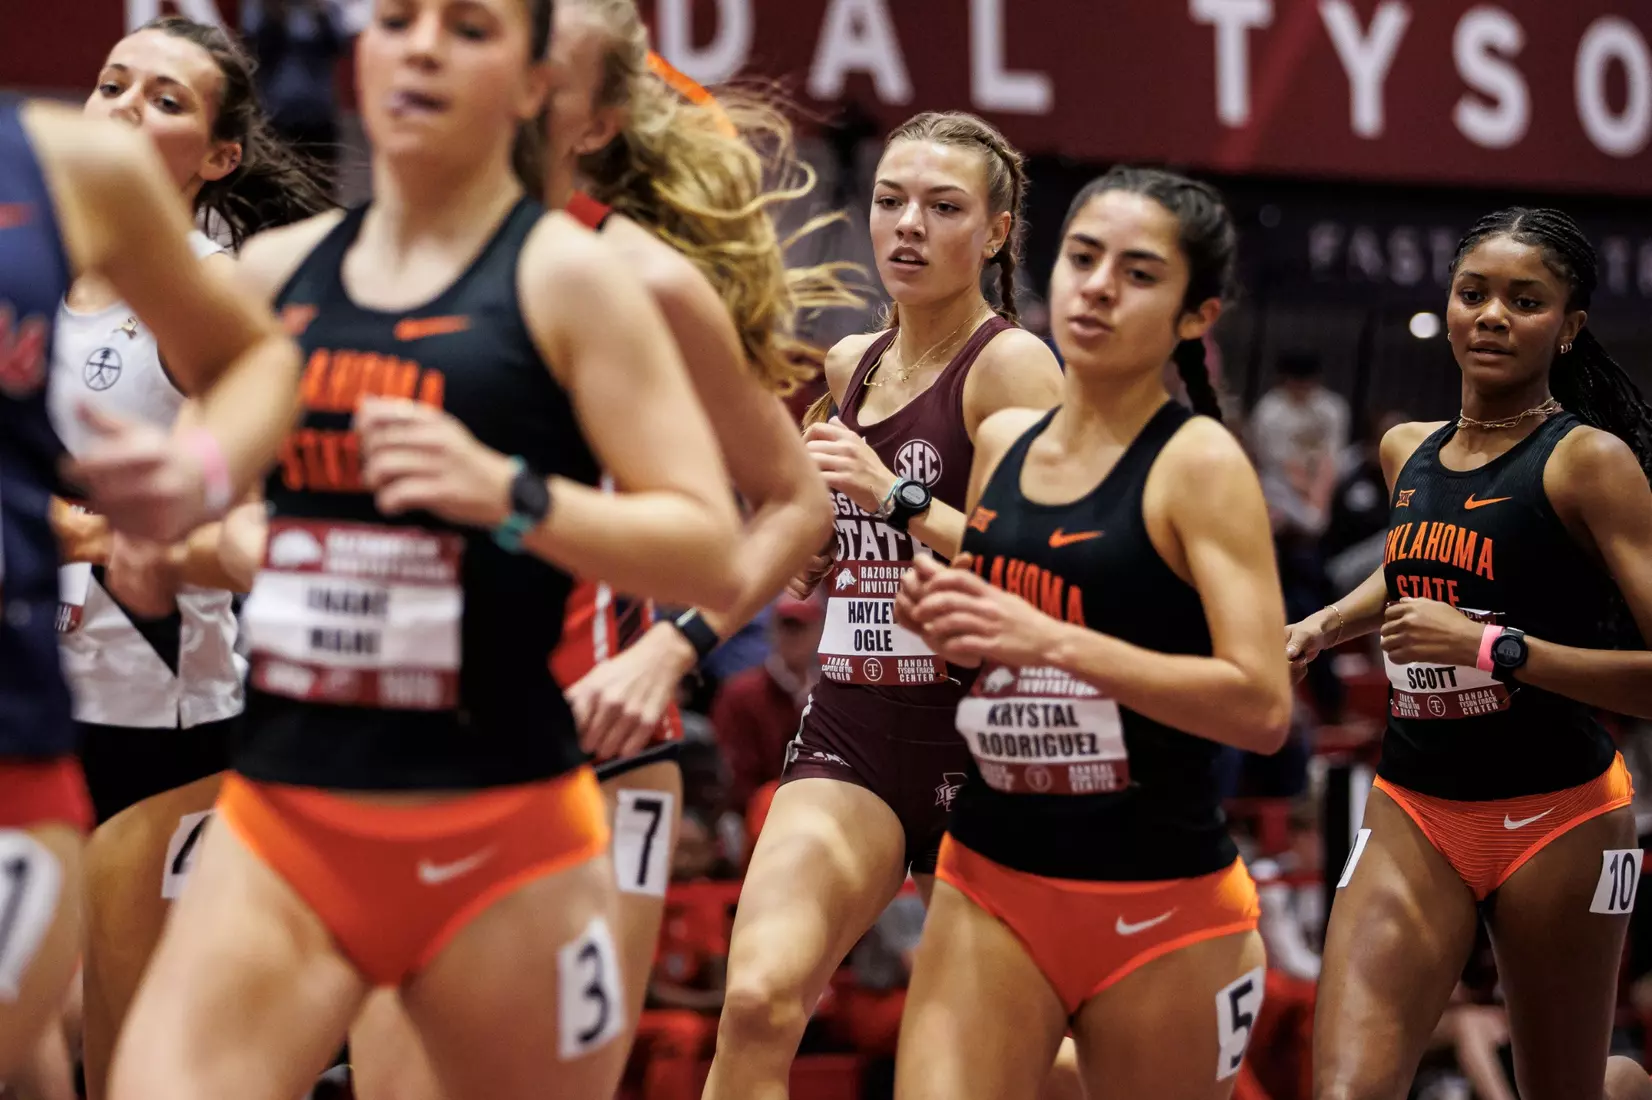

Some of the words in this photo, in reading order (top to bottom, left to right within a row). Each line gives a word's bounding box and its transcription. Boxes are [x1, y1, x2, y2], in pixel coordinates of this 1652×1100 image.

[898, 443, 938, 483] SEC
[1383, 521, 1495, 581] OKLAHOMA
[861, 581, 899, 594] INVITAT
[854, 629, 894, 652] OGLE
[898, 659, 933, 668] RANDAL
[899, 674, 934, 683] CENTER
[1407, 666, 1458, 690] SCOTT
[1458, 689, 1495, 702] RANDAL
[987, 703, 1079, 728] KRYSTAL
[1462, 703, 1499, 716] CENTER
[977, 732, 1100, 758] RODRIGUEZ
[634, 798, 663, 886] 7
[1609, 852, 1637, 911] 10
[577, 942, 609, 1043] 3
[1229, 979, 1254, 1069] 5
